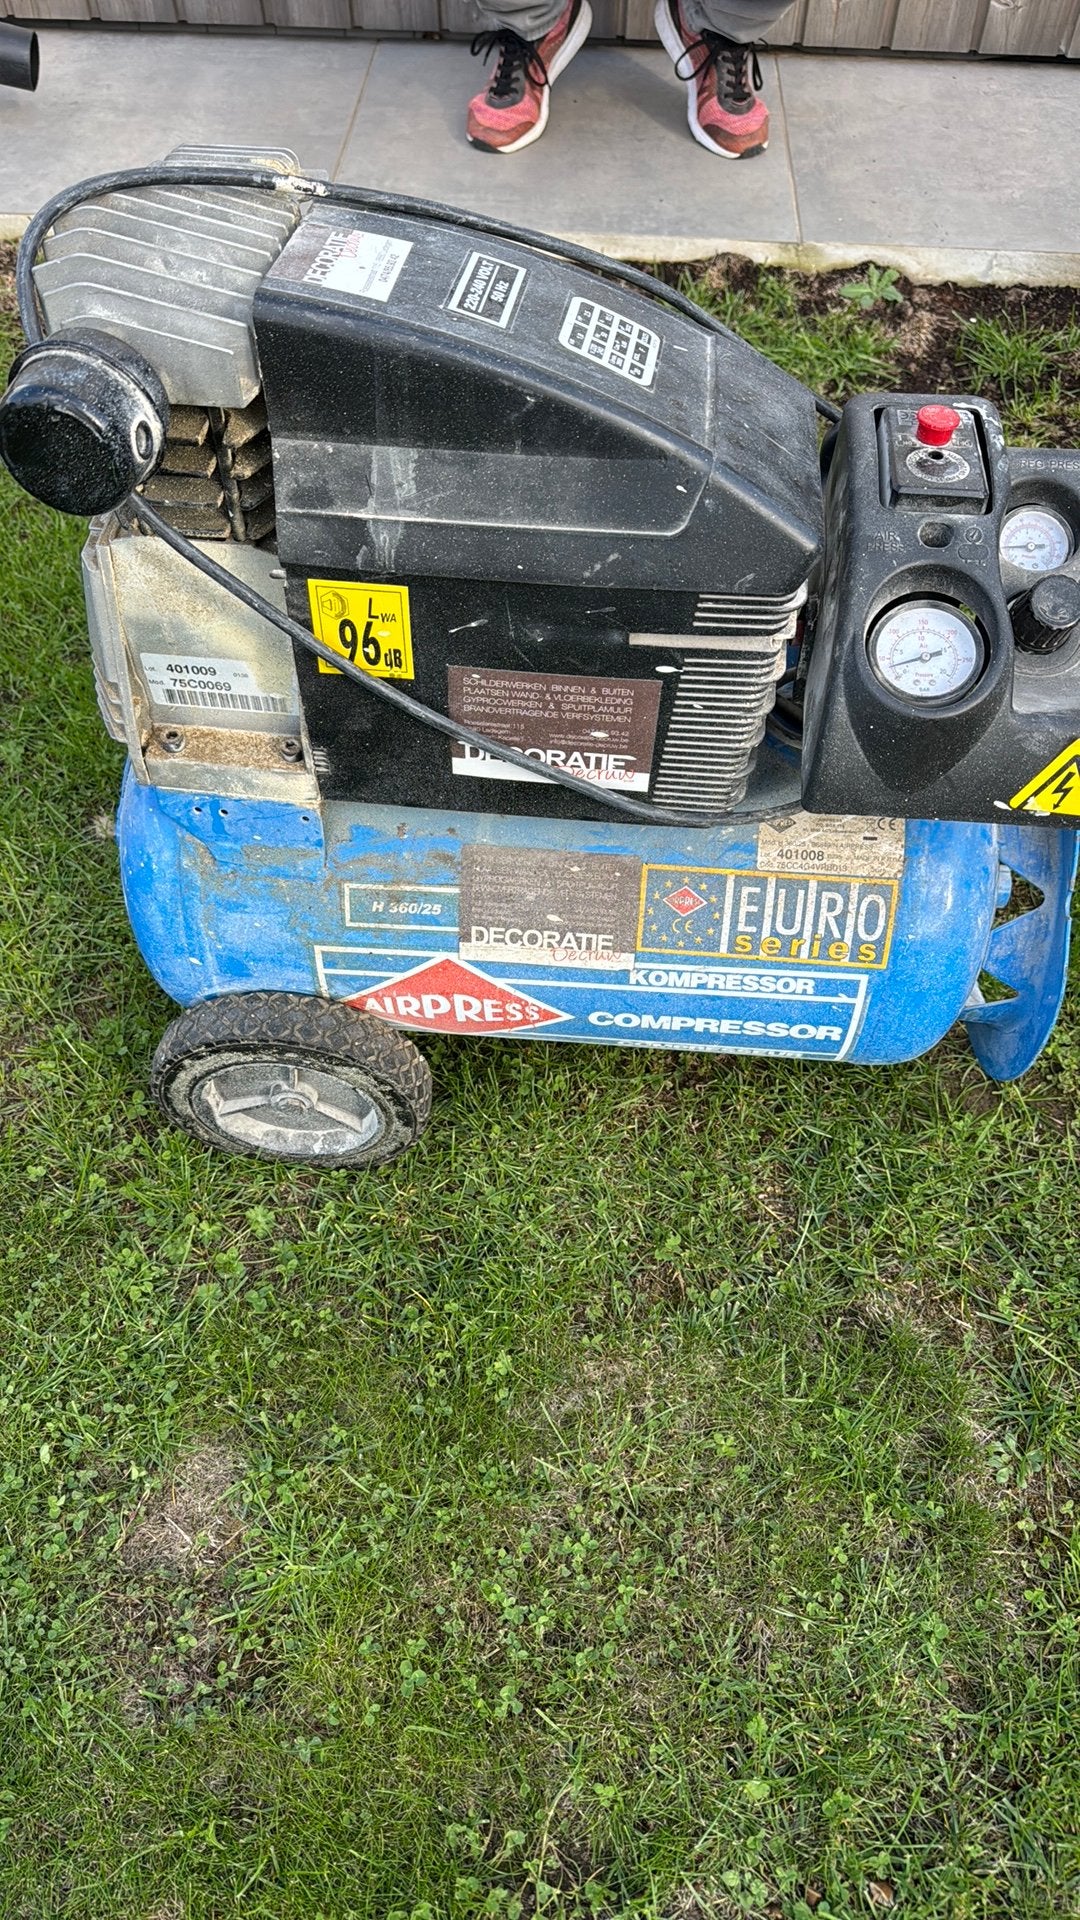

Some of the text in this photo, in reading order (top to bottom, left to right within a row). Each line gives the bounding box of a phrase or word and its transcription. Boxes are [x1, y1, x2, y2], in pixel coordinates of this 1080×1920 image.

[301, 231, 348, 286] DECORATIE
[463, 260, 494, 311] 220-240 VOLT
[490, 280, 510, 303] 50 Hz
[867, 541, 905, 552] PRESS
[873, 530, 900, 542] AIR
[338, 618, 381, 667] 96
[166, 663, 217, 677] 401009
[384, 648, 402, 671] dB
[170, 677, 232, 692] 75C0069
[462, 676, 635, 698] SCHILDERWERKEN BINNEN & BUITEN
[462, 686, 510, 698] PLAATSEN
[545, 692, 552, 701] &
[553, 693, 634, 706] VLOERBEKLEDING
[462, 695, 633, 715] GYPROCWERKEN & SPUITPLAMUUR
[463, 704, 632, 723] BRANDVERTRAGENDE VERFSYSTEMEN
[463, 741, 628, 770] DORATIE
[776, 848, 825, 862] 401008
[371, 901, 442, 916] H 360/25
[736, 885, 887, 942] EURO
[471, 925, 615, 952] DECORATIE
[734, 933, 878, 963] series
[628, 969, 816, 996] KOMPRESSOR
[364, 992, 541, 1023] AIRPRESS
[588, 1011, 844, 1042] COMPRESSOR
